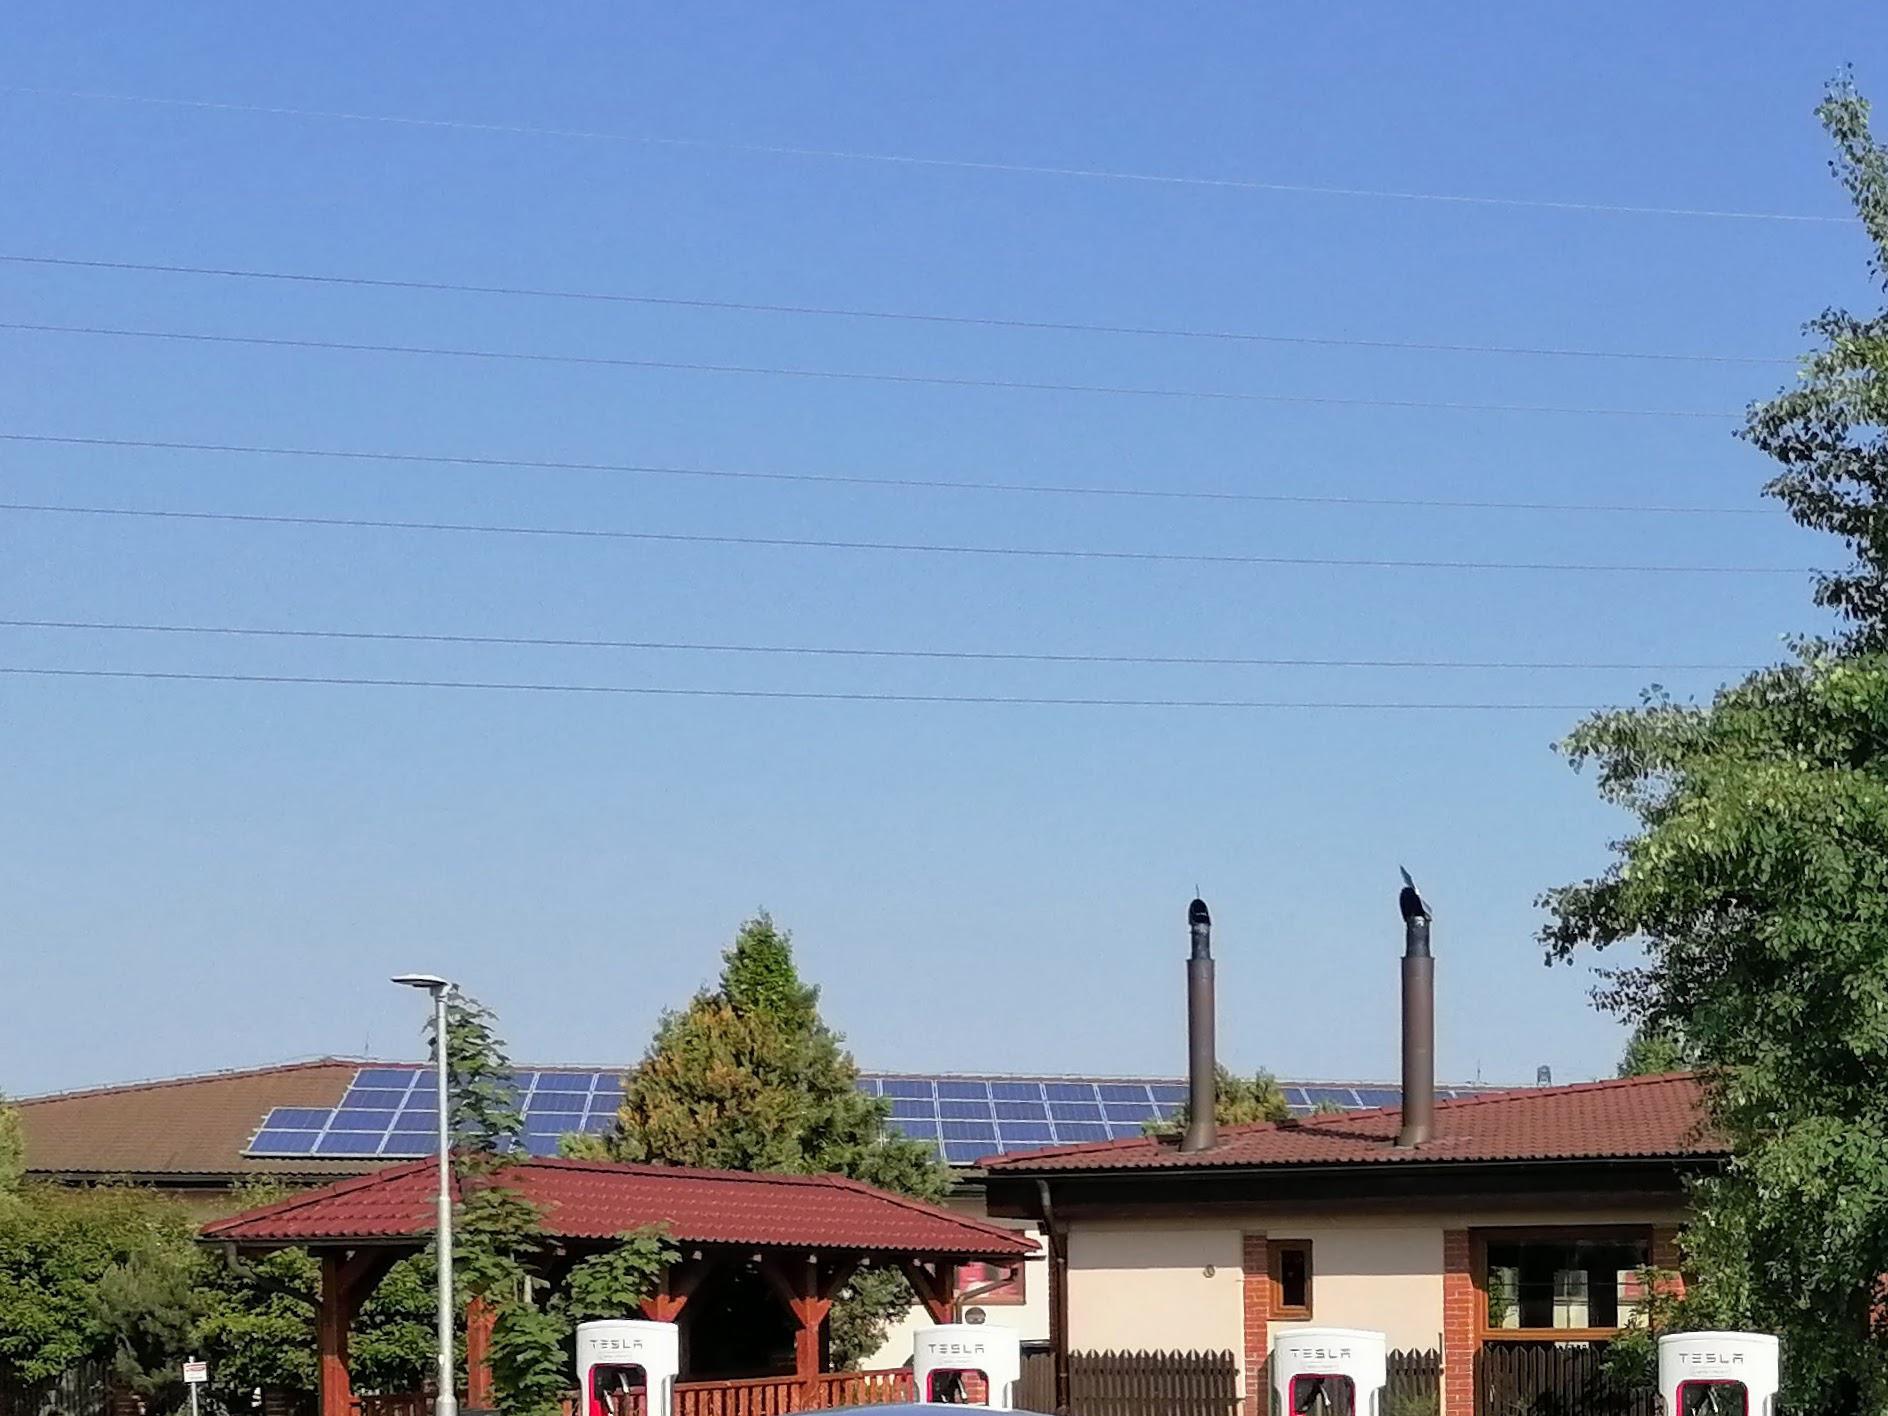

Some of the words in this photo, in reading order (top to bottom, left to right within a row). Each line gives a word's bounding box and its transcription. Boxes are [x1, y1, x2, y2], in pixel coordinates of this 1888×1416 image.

[589, 1338, 643, 1350] TESLA
[928, 1343, 985, 1354] TESLA
[1289, 1348, 1351, 1359] TESLA
[1679, 1352, 1744, 1364] TESLA
